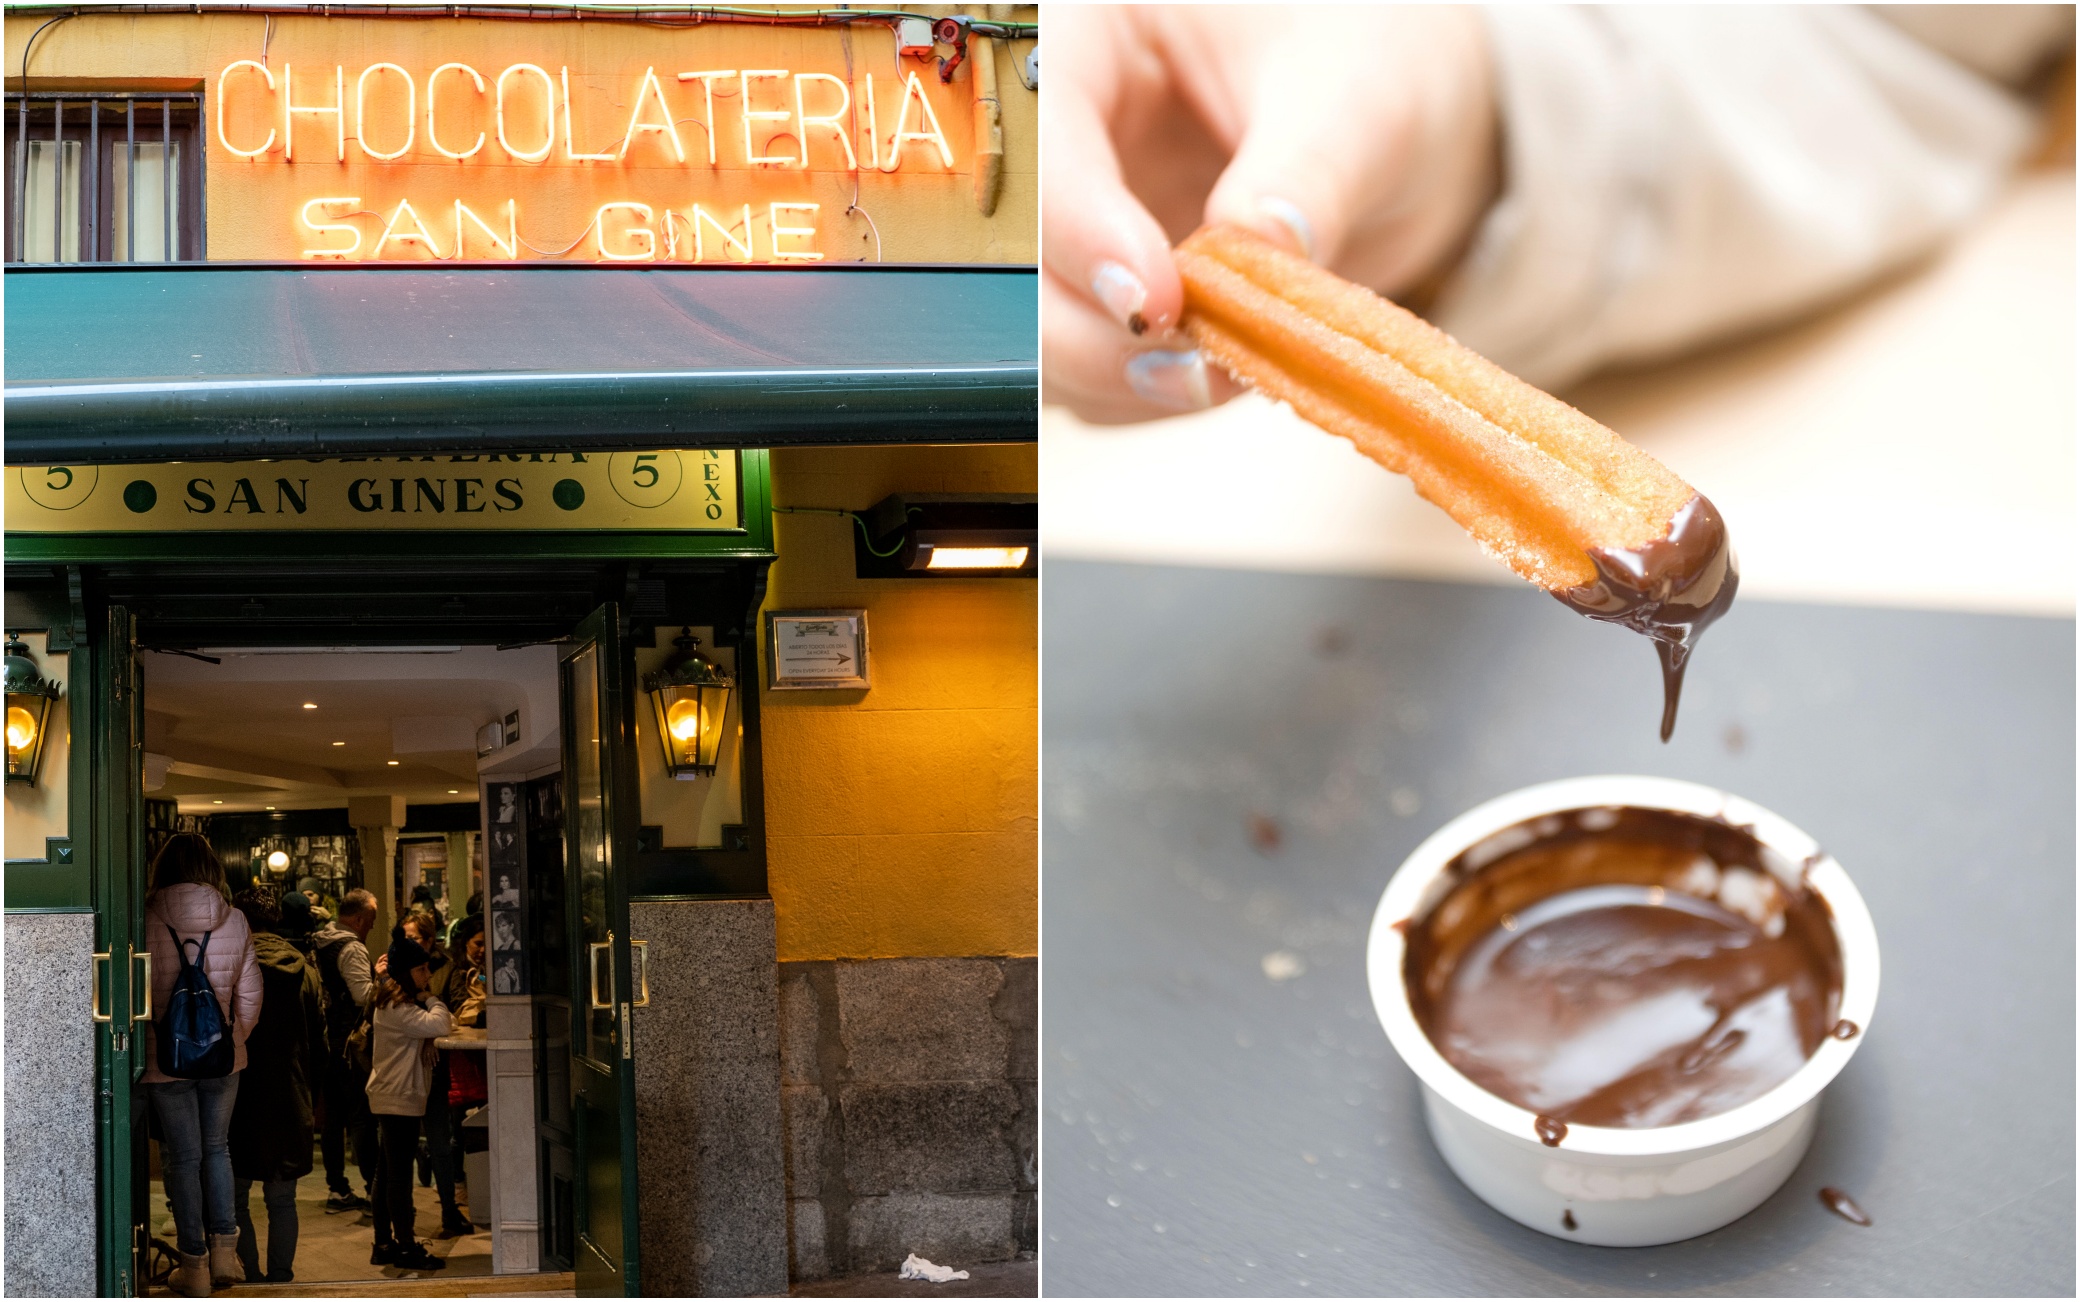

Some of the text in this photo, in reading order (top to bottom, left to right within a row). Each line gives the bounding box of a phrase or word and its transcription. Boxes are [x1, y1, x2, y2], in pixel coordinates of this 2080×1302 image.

[216, 60, 954, 168] CHOCOLATERIA
[301, 197, 825, 262] SAN GINE
[46, 466, 73, 490] 5
[632, 454, 659, 488] 5
[183, 477, 525, 514] SAN GINES
